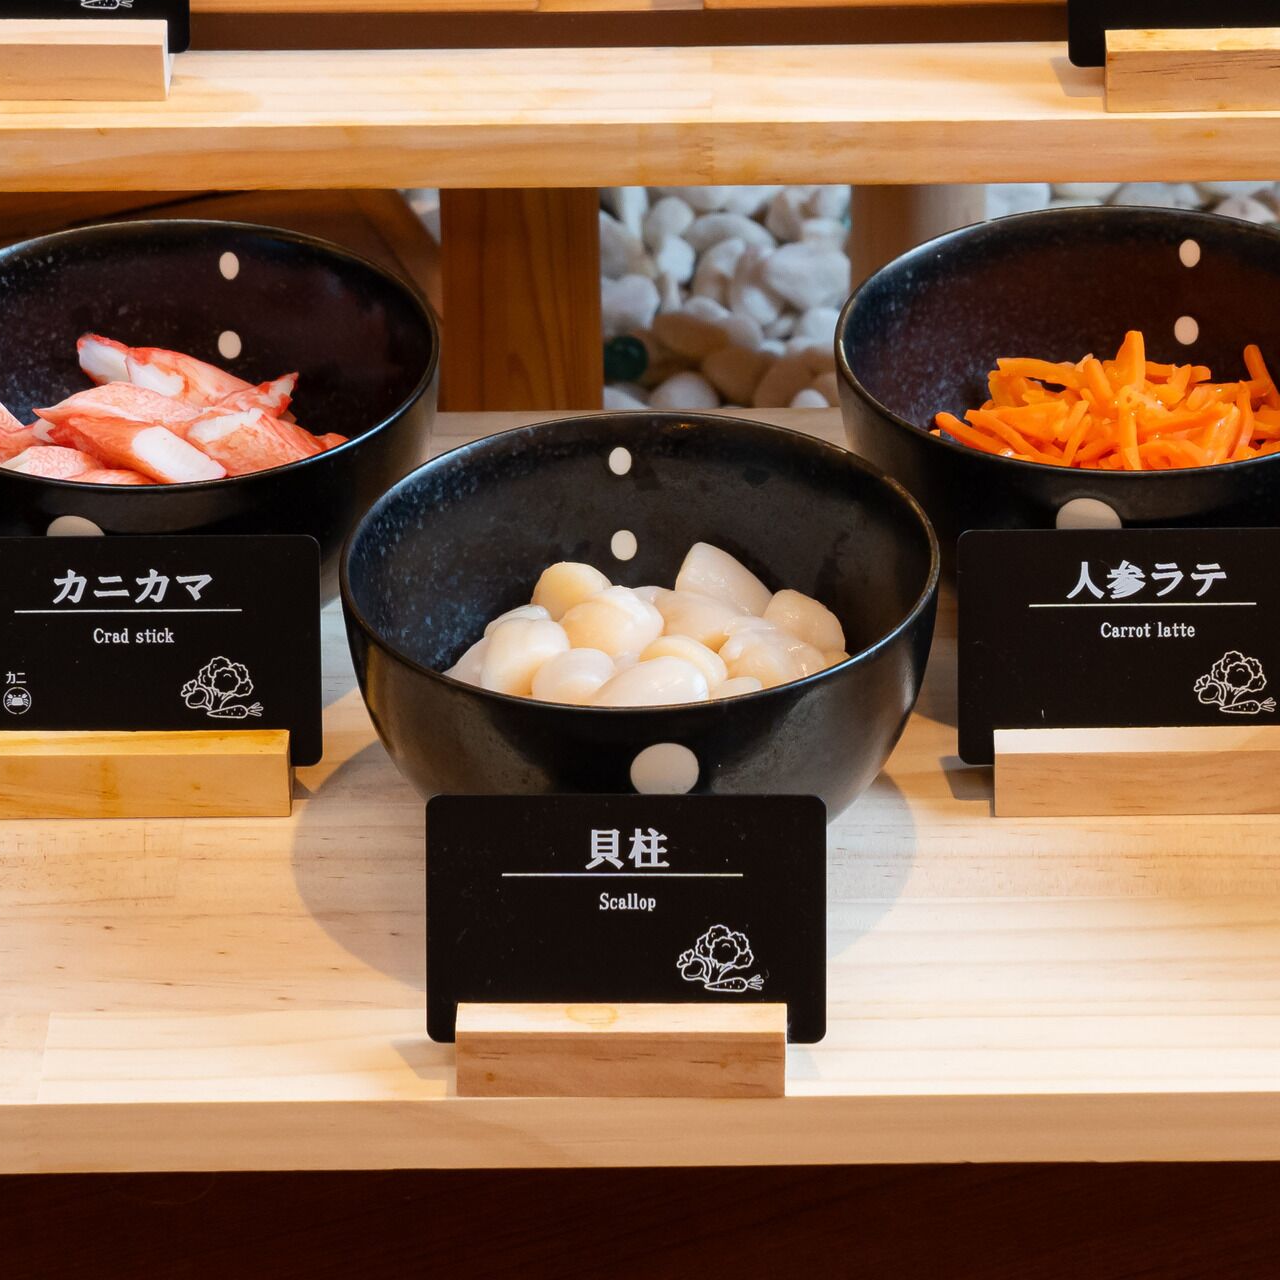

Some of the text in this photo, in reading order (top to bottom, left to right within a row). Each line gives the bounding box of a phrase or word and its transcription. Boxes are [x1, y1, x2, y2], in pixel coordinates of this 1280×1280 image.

[53, 569, 214, 606] カニカマ
[1066, 560, 1229, 601] 人参ラテ
[94, 628, 176, 645] Crad stick
[1101, 622, 1197, 640] Carrot latte
[6, 672, 28, 686] カニ
[585, 828, 671, 871] 貝柱
[600, 893, 658, 913] Scallop
